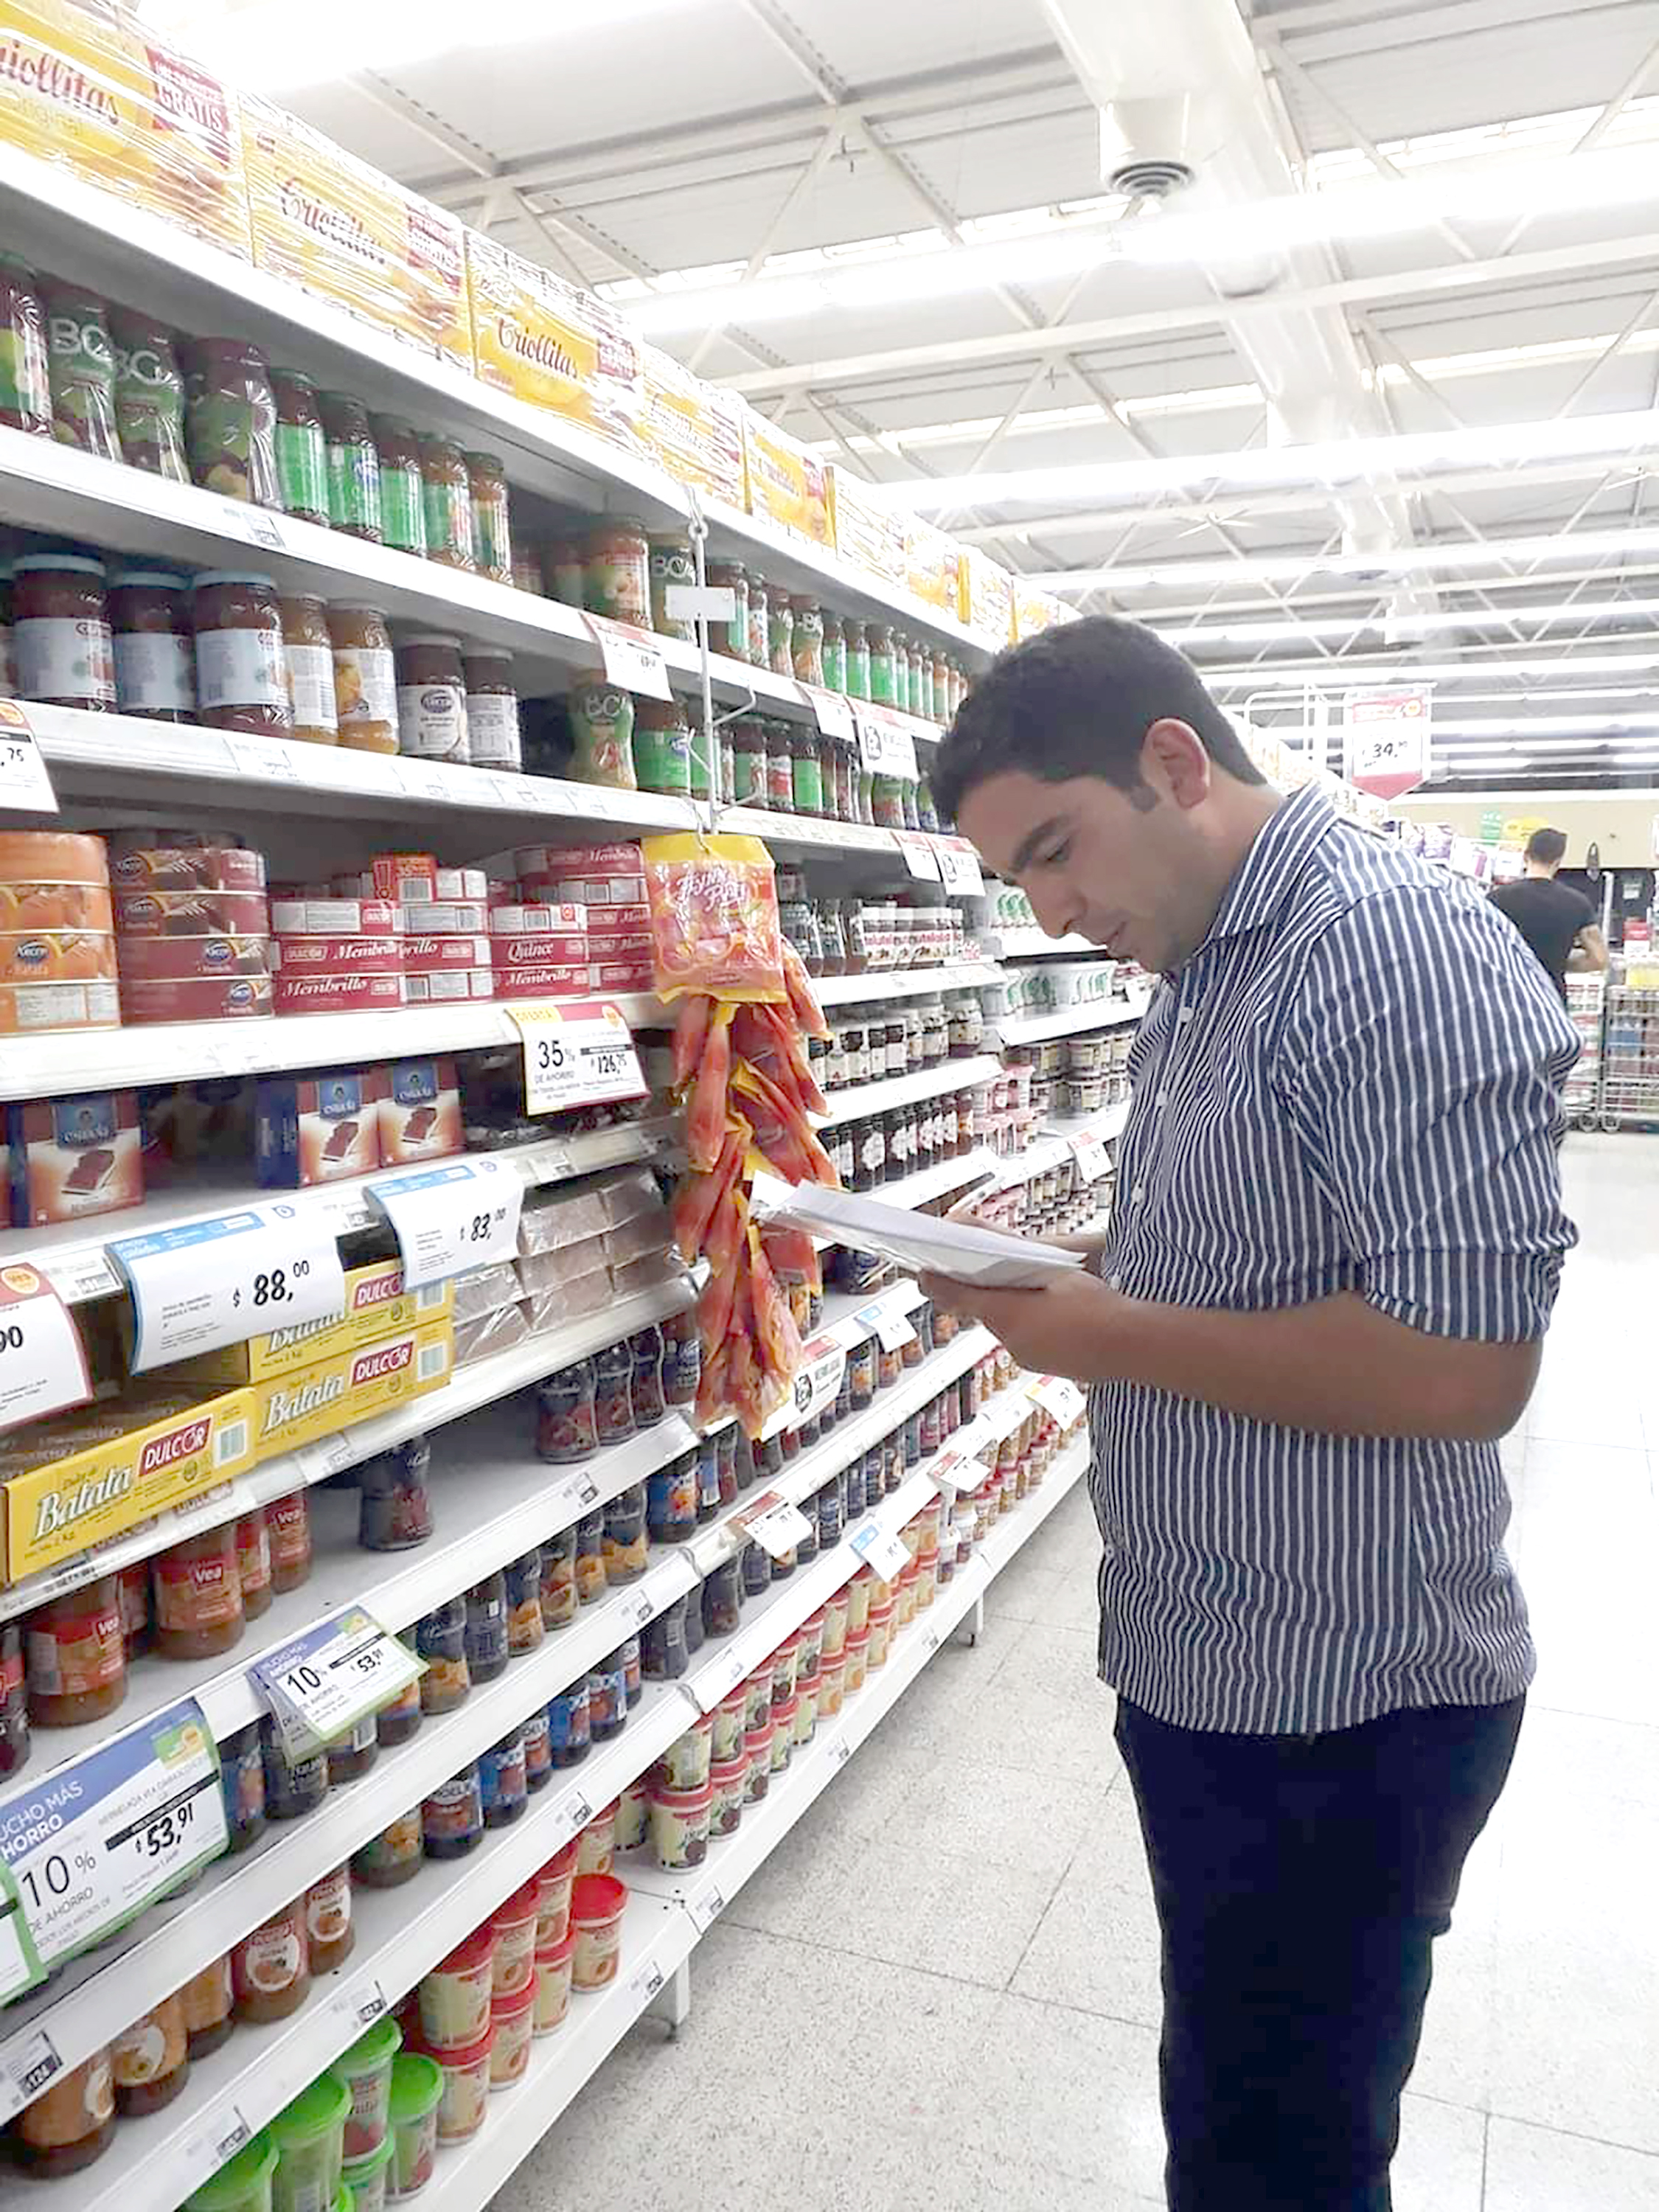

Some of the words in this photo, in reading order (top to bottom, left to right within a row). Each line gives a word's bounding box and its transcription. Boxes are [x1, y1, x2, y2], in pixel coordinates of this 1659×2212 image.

[497, 317, 579, 380] Criollitas
[282, 976, 367, 997] Membrillo
[355, 1346, 411, 1380] DULCOR
[263, 1375, 345, 1434] Batata
[145, 1425, 206, 1470] DULCOR
[34, 1465, 133, 1541] Batata
[46, 1778, 84, 1812] MÁS
[45, 1886, 94, 1925] AHORRO
